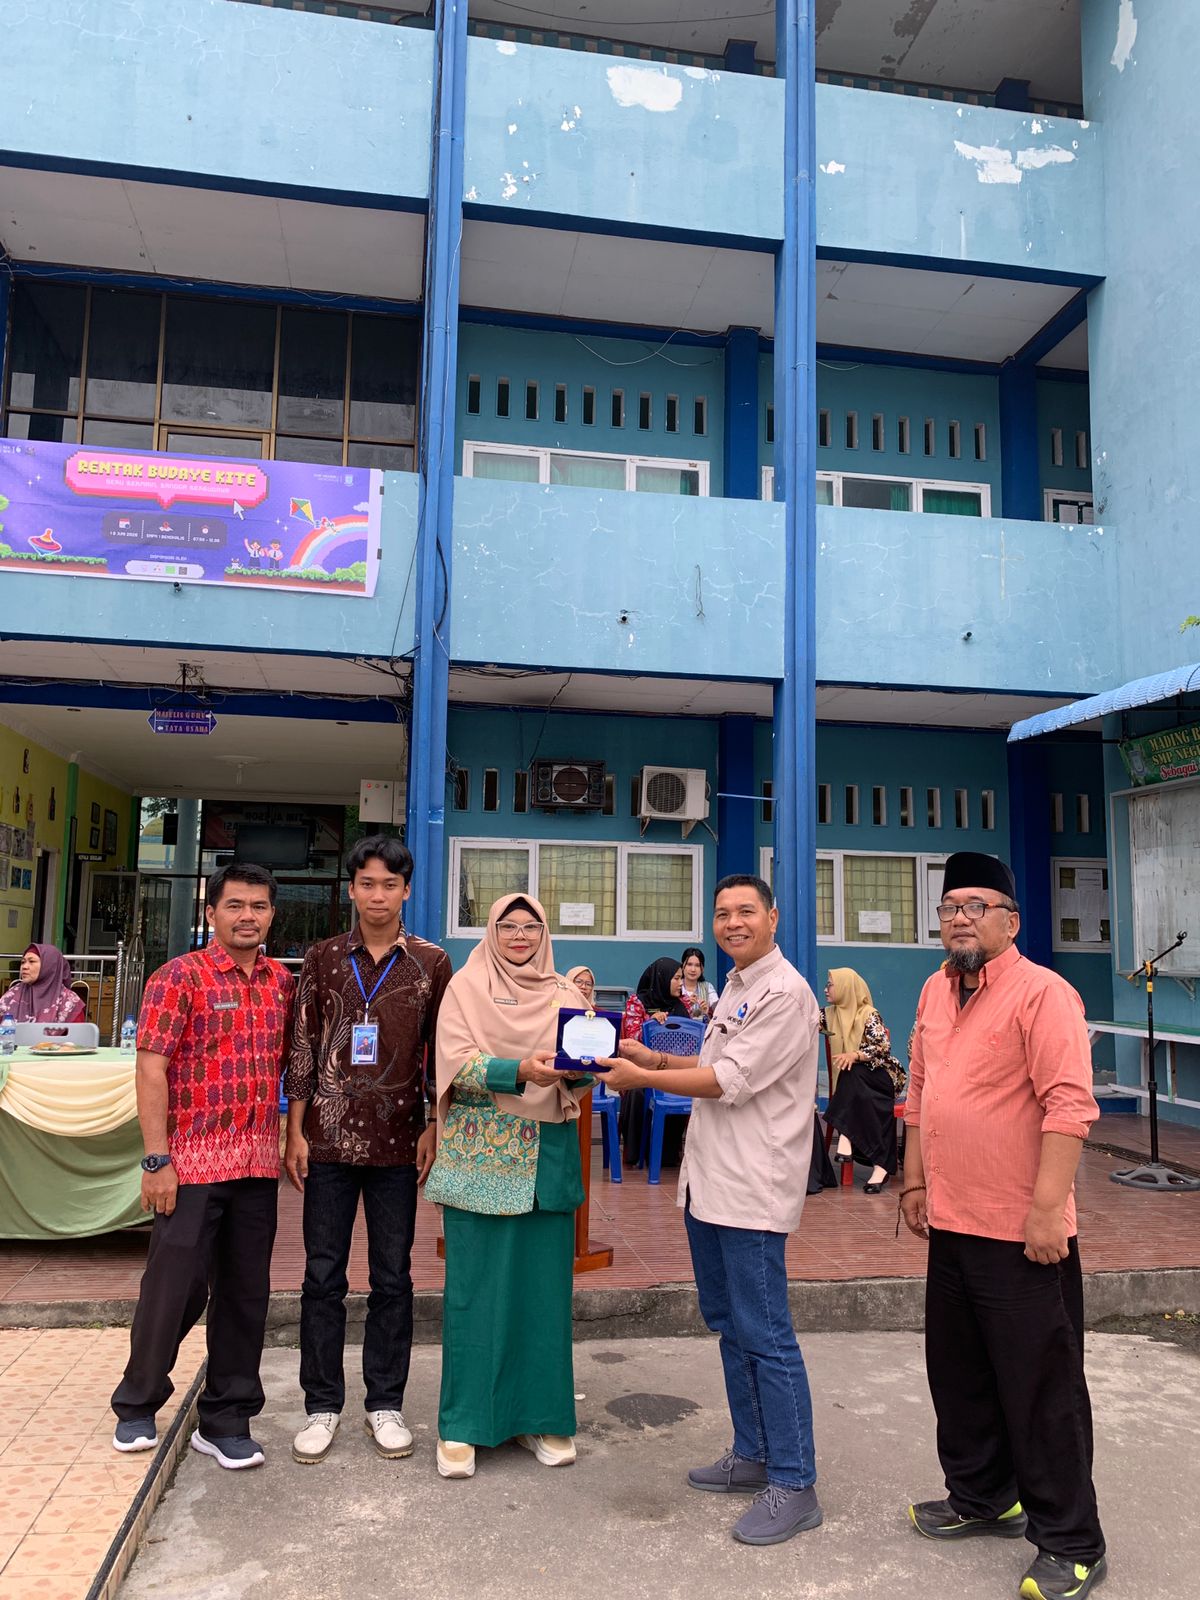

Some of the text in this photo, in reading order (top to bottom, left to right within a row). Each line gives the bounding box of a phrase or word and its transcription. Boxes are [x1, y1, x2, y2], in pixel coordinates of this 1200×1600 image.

[78, 460, 257, 487] RENTAK BUDAYE KITE
[165, 724, 183, 732] TATA
[1152, 751, 1173, 766] SMP
